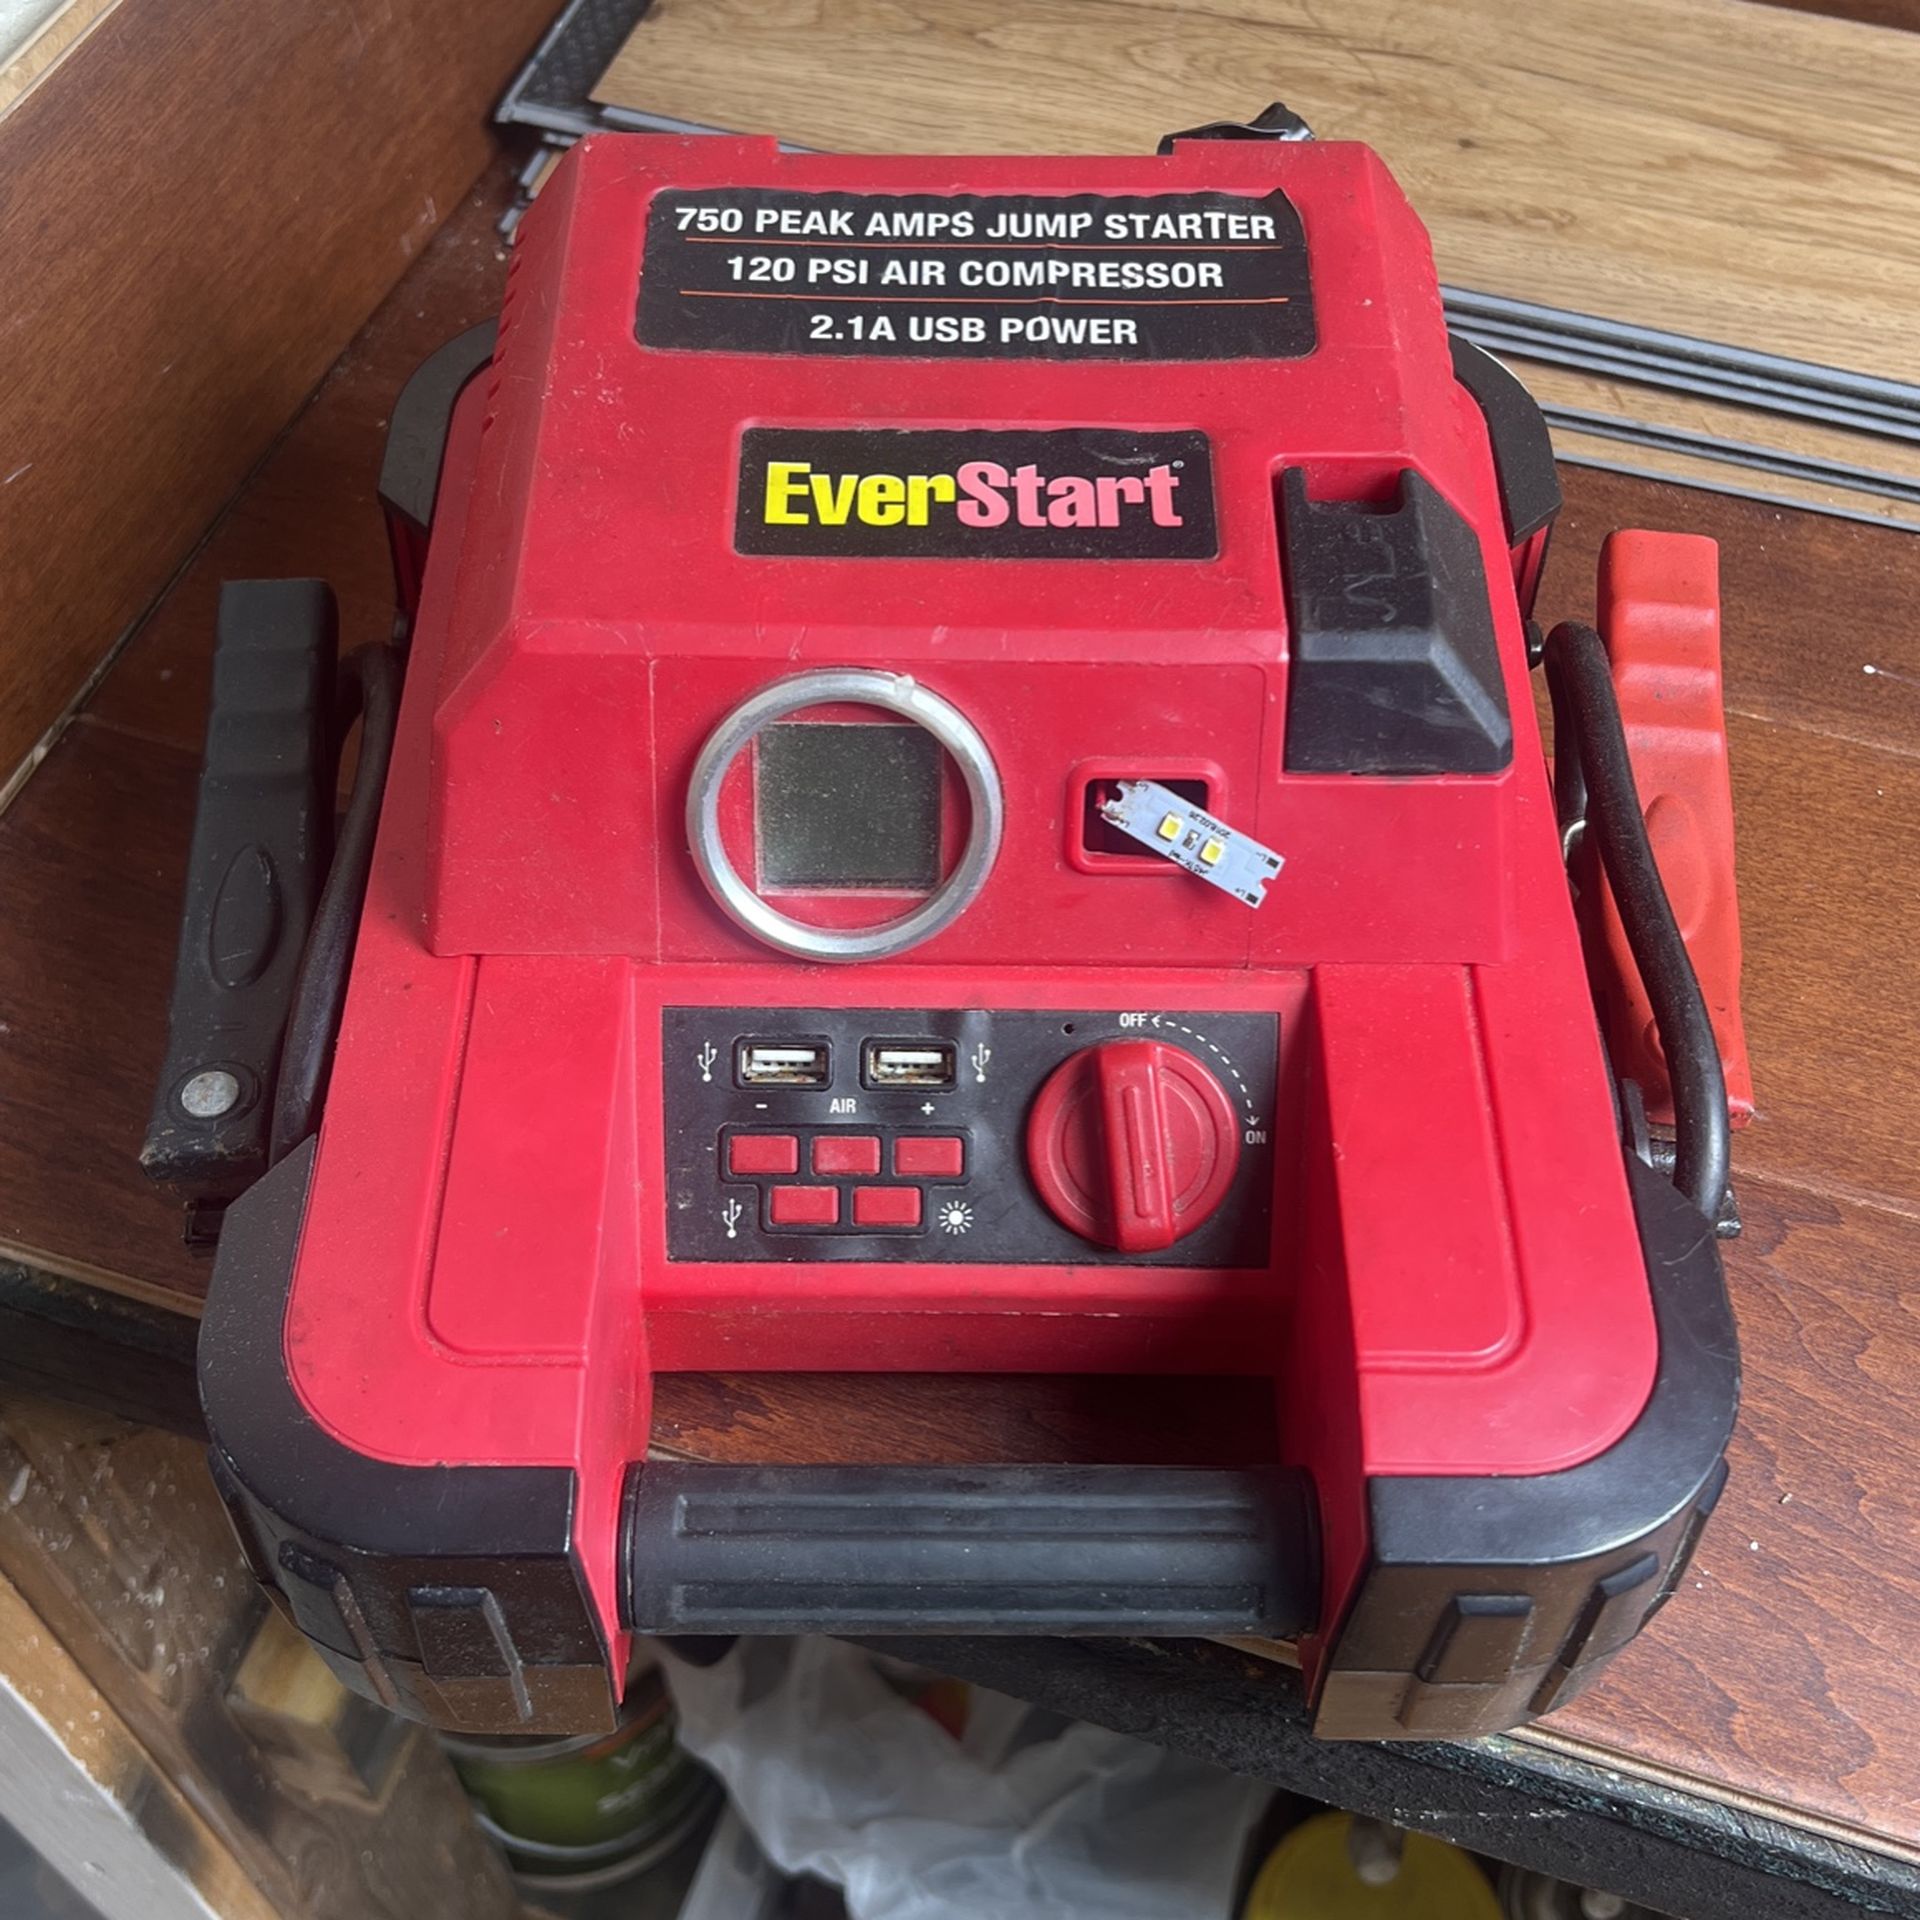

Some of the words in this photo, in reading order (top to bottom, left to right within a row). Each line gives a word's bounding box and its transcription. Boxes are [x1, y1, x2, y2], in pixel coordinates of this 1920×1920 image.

[675, 207, 743, 233] 750
[755, 208, 854, 236] PEAK
[864, 211, 975, 238] AMPS
[986, 212, 1093, 239] JUMP
[1104, 212, 1277, 240] STARTER
[727, 255, 796, 282] 120
[807, 257, 869, 285] PSI
[880, 260, 946, 286] AIR
[959, 260, 1225, 289] COMPRESSOR
[809, 314, 898, 341] 2.1A
[909, 316, 986, 343] USB
[1000, 315, 1138, 345] POWER
[1119, 1012, 1148, 1028] OFF
[829, 1098, 857, 1114] AIR
[1245, 1130, 1267, 1144] ON
